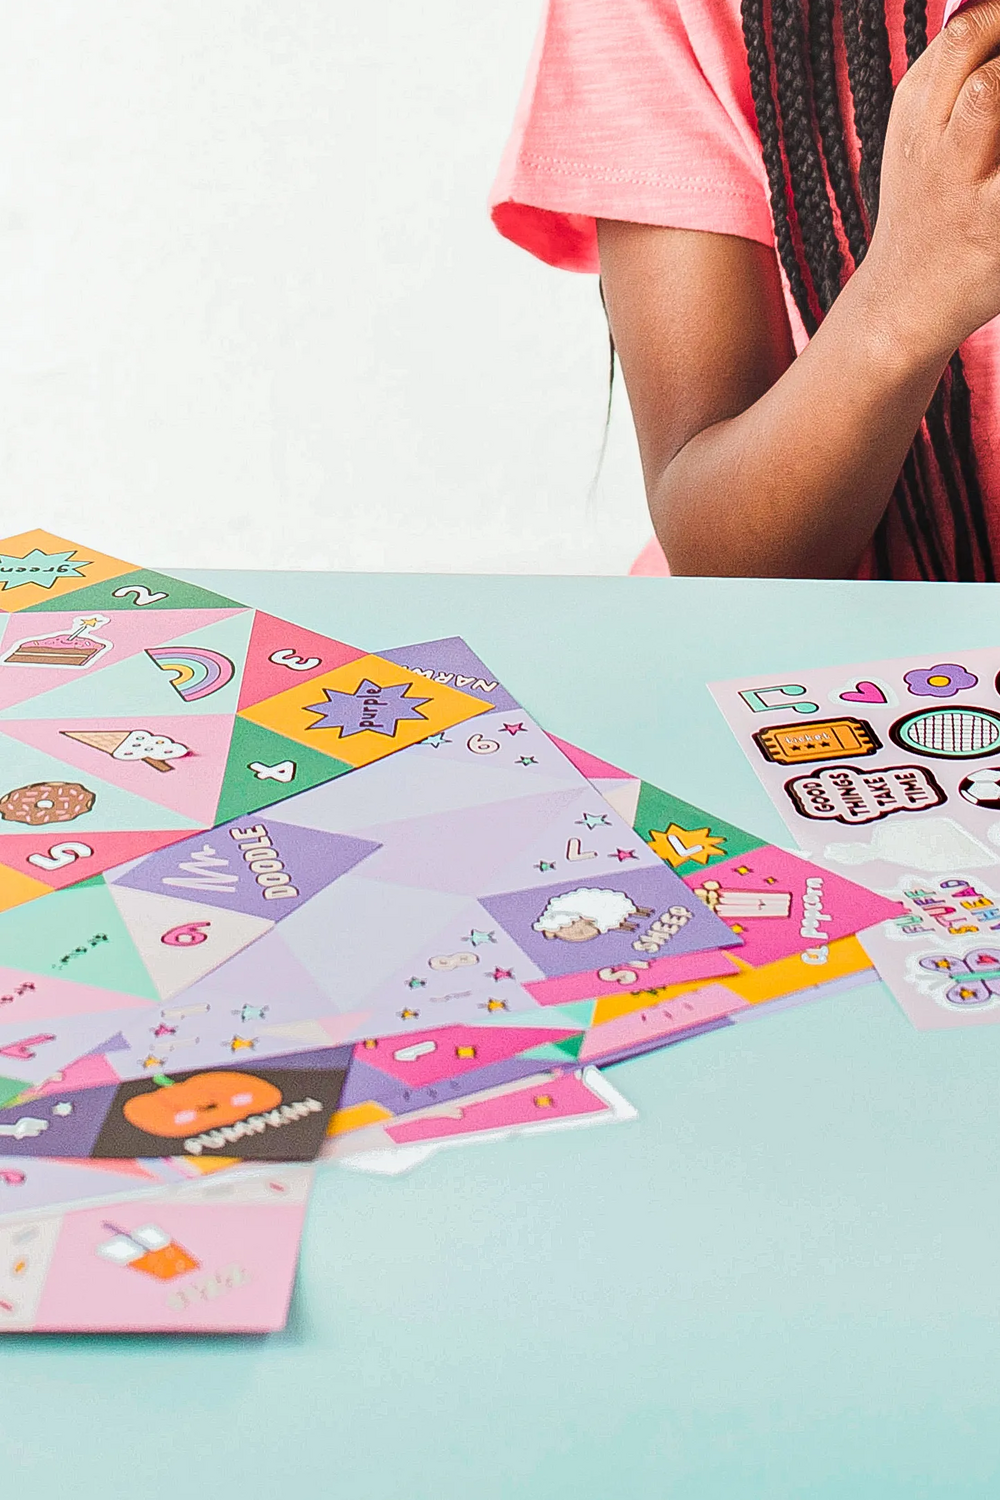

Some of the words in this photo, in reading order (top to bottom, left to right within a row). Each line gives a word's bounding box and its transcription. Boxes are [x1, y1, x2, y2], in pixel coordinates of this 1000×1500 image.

[0, 564, 70, 575] green
[112, 585, 169, 606] 2
[270, 648, 323, 671] 3
[359, 684, 382, 728] purple
[784, 730, 831, 745] ticket
[248, 760, 297, 784] 4
[802, 782, 835, 813] GOOD
[828, 773, 871, 817] THINGS
[862, 776, 898, 807] TAKE
[894, 772, 929, 804] TIME
[26, 842, 94, 871] 5
[229, 824, 300, 901] DOODLE
[904, 888, 980, 935] STUFF
[632, 905, 695, 953] SHEEP
